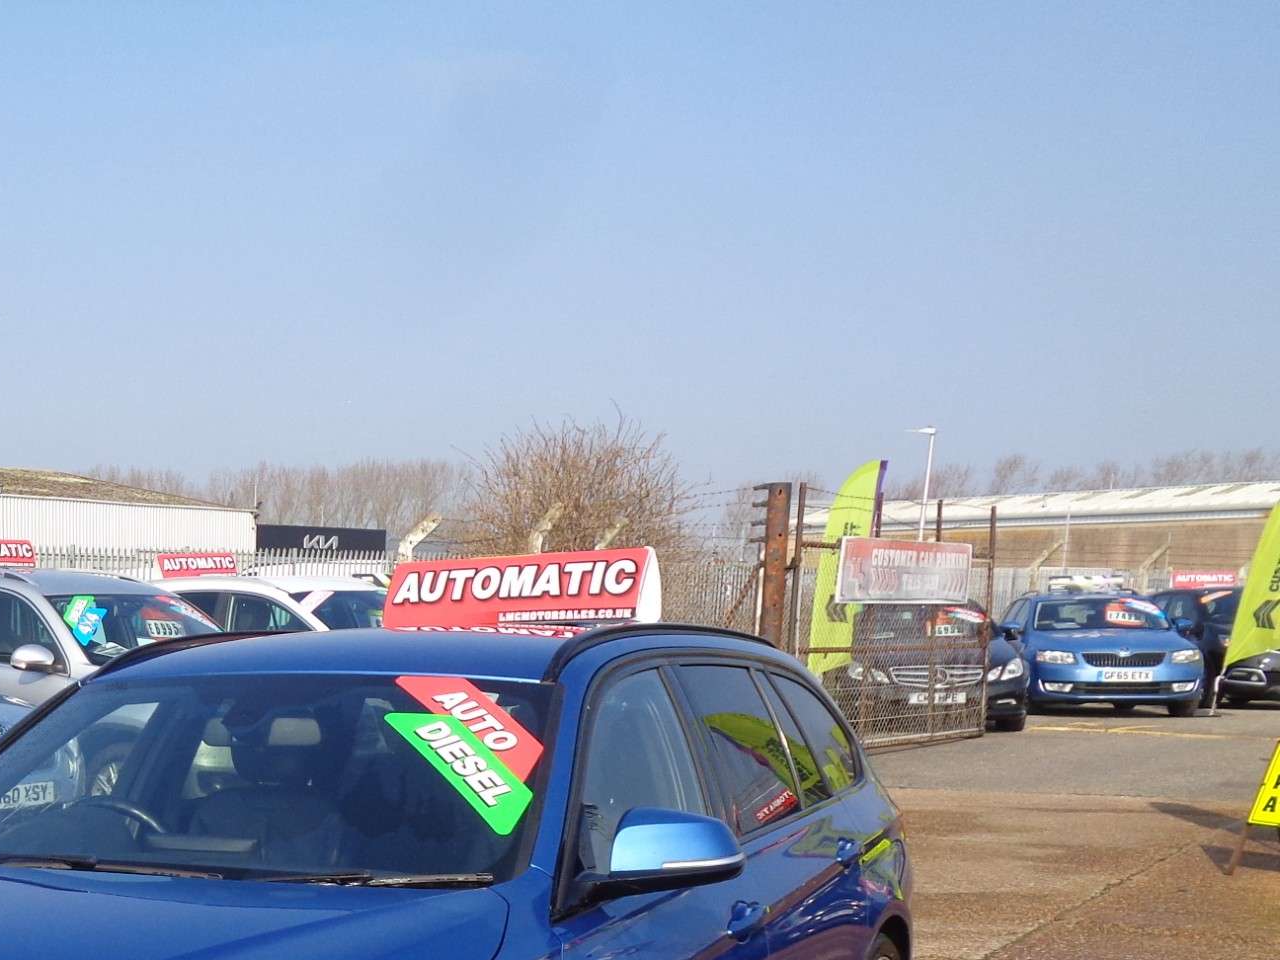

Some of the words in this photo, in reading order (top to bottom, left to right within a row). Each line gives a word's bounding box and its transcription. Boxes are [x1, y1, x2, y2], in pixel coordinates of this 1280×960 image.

[303, 534, 339, 550] KIA
[163, 556, 235, 571] AUTOMATIC
[392, 558, 638, 605] AUTOMATIC
[1175, 574, 1235, 583] AUTOMATIC
[432, 691, 519, 751] AUTO
[414, 720, 512, 808] DIESEL
[0, 787, 20, 804] 60
